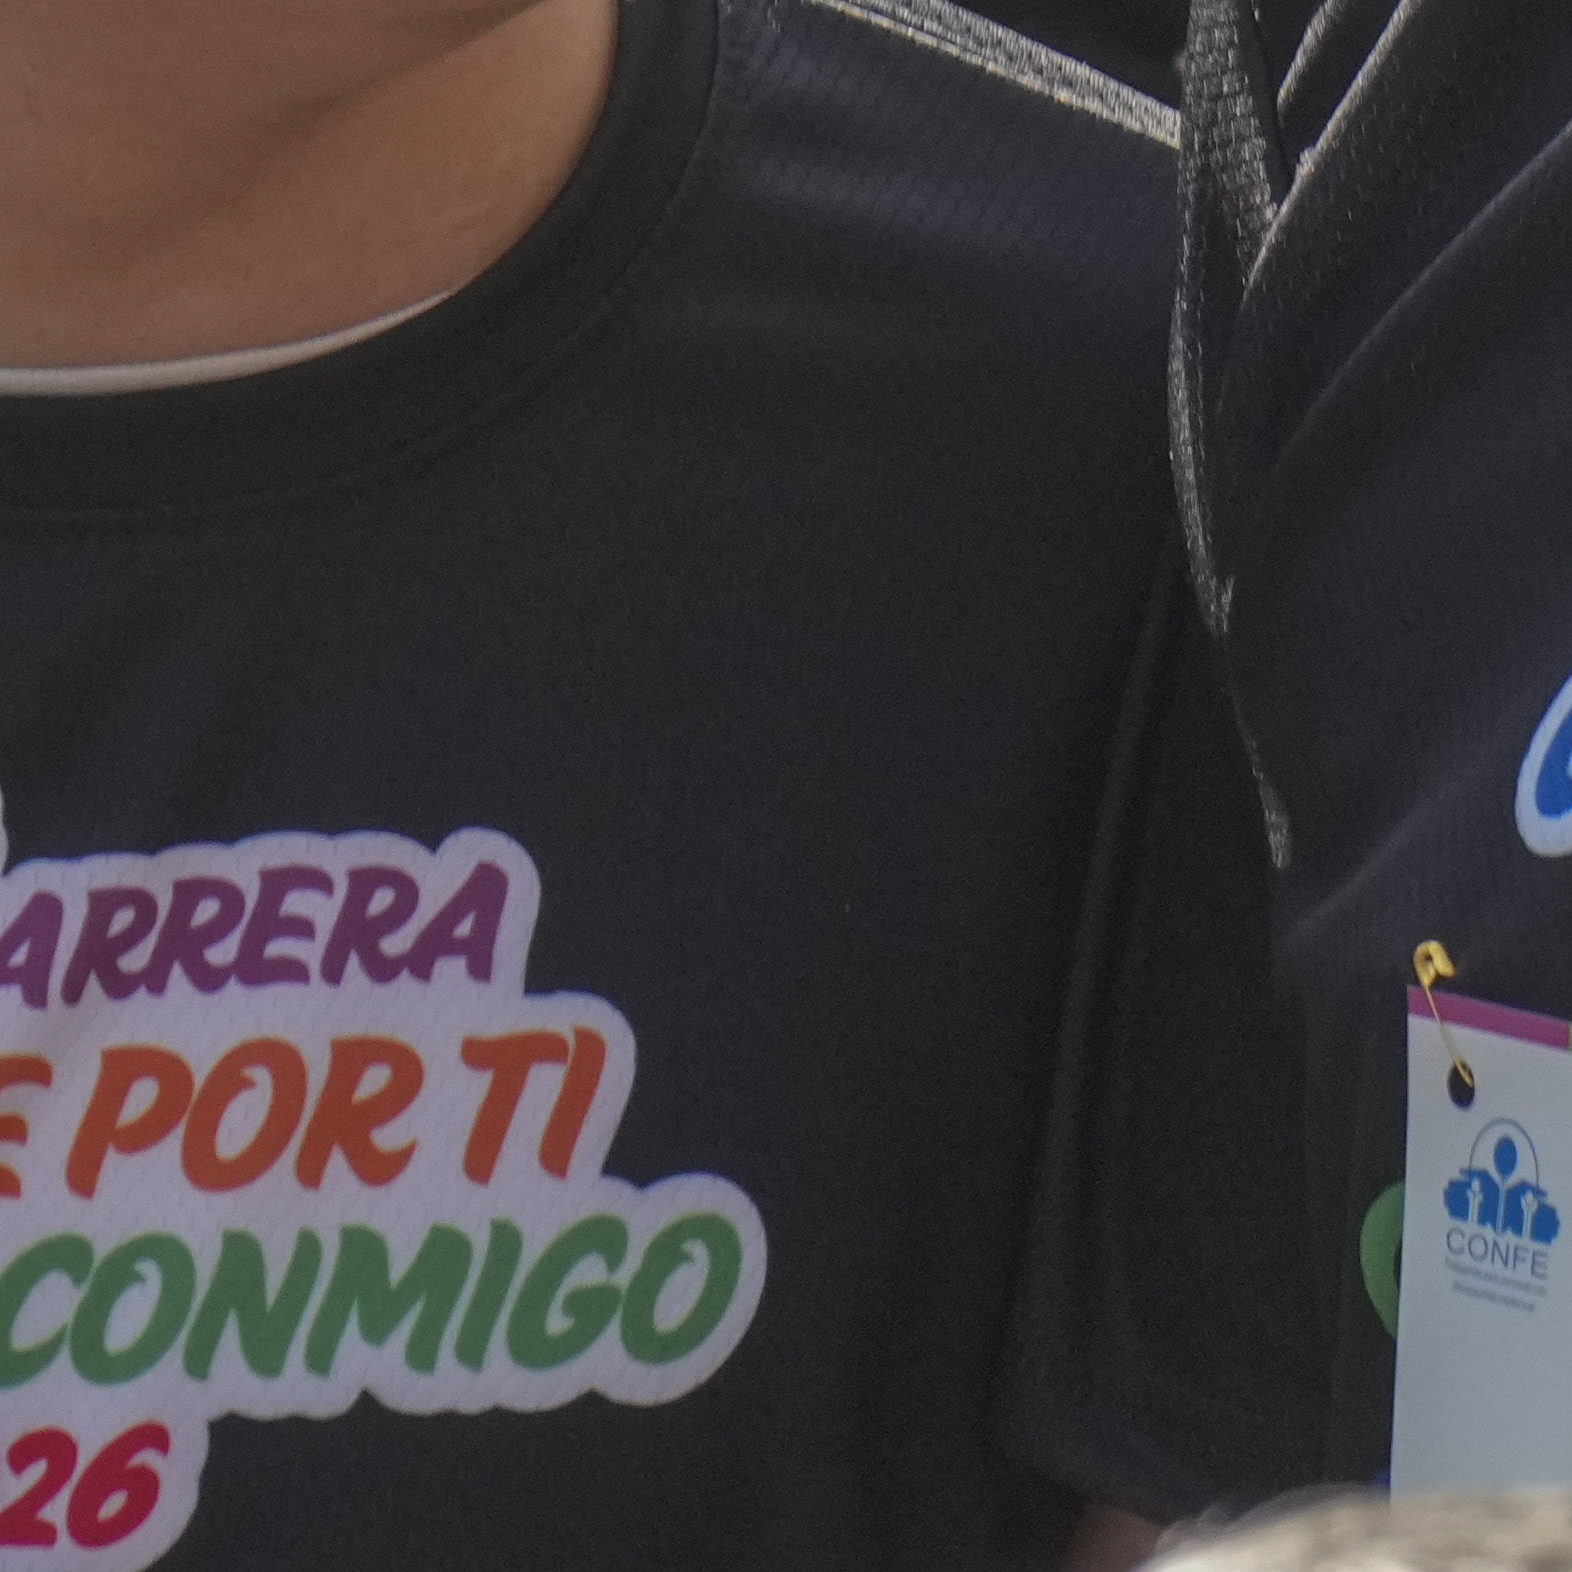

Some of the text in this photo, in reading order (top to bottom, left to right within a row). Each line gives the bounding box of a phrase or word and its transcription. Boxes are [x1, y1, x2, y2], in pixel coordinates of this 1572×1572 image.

[64, 1035, 427, 1201] POR
[460, 1025, 608, 1186] TI
[0, 1210, 743, 1391] CONMIGO
[1446, 1226, 1549, 1281] CONFE
